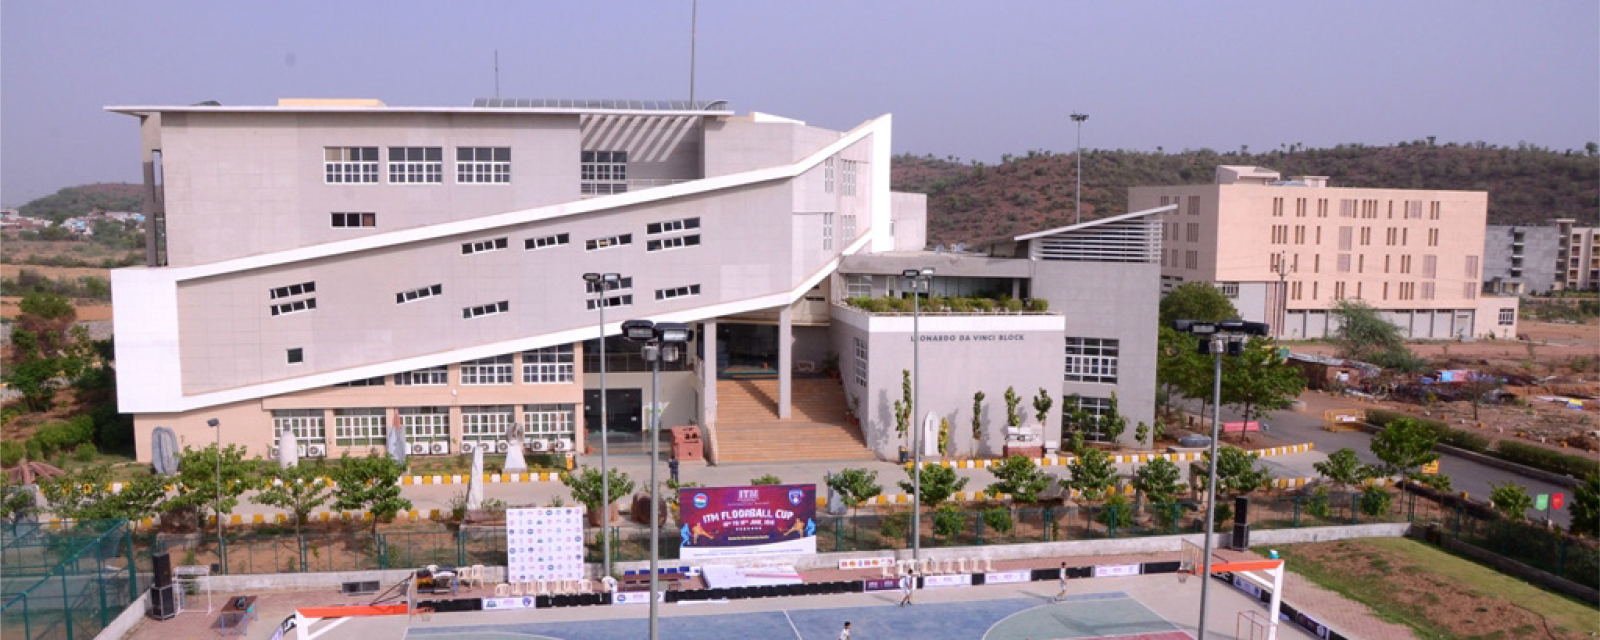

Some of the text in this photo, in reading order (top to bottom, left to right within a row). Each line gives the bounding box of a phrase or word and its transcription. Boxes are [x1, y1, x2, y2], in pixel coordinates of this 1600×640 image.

[910, 334, 956, 342] LONARDO
[998, 333, 1025, 341] BLOCK
[738, 489, 758, 499] ITM
[702, 508, 794, 523] ITM FLOORBALL CUP
